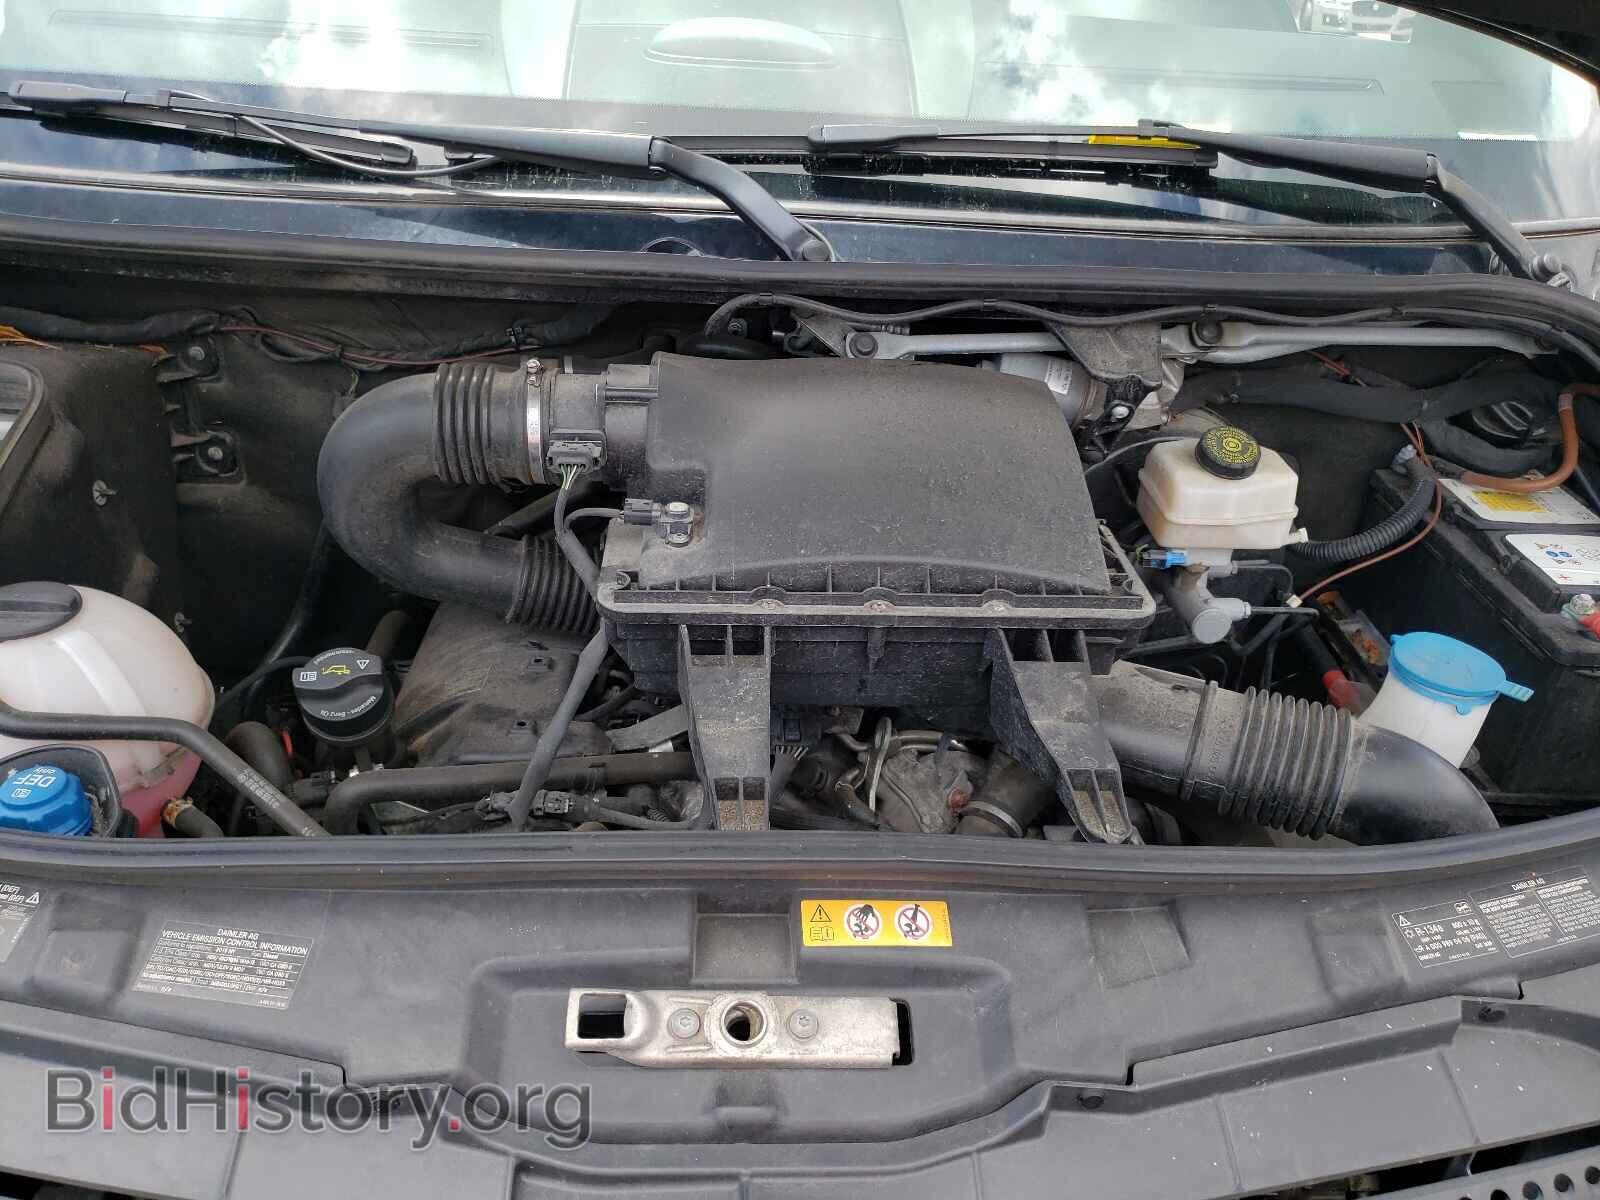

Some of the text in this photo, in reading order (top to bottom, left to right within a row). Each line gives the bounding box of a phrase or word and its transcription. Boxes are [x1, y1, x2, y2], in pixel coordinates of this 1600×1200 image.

[12, 773, 57, 788] DEF
[217, 927, 260, 941] DAIMLER AG
[162, 929, 192, 942] VEHICLE
[191, 932, 225, 946] EMISSION
[224, 937, 258, 949] CONTROL
[259, 941, 309, 956] INFORMATION
